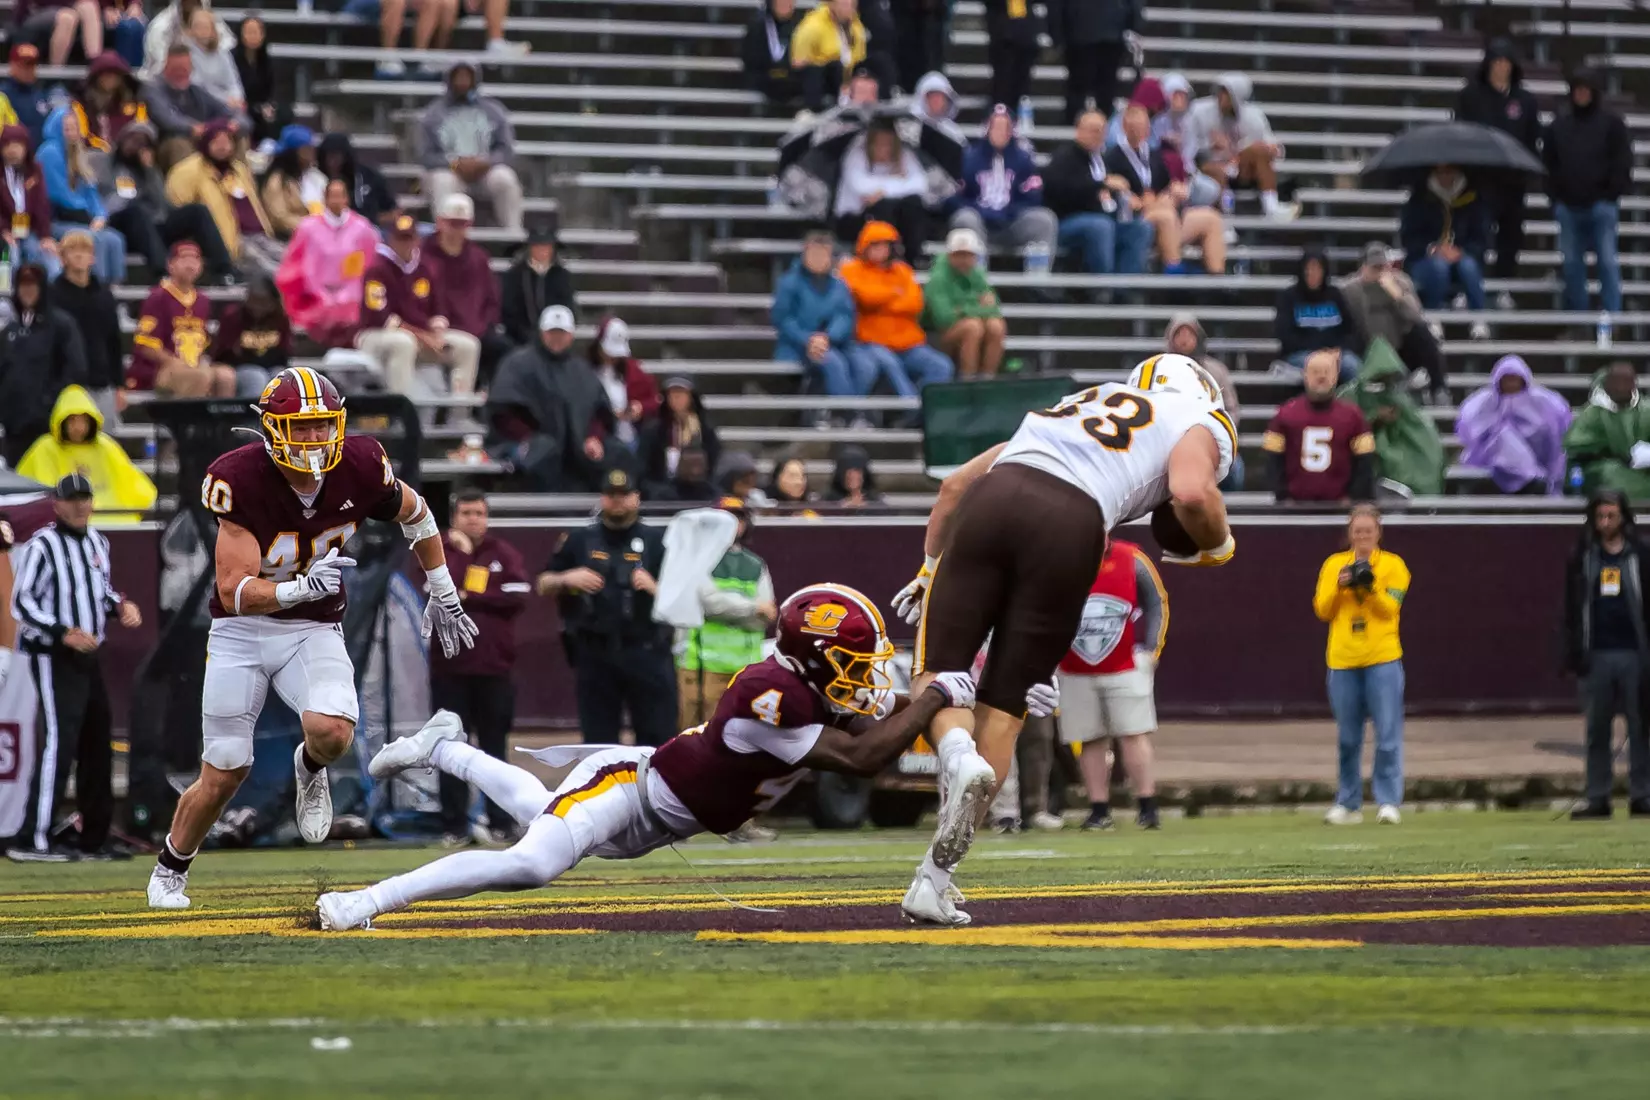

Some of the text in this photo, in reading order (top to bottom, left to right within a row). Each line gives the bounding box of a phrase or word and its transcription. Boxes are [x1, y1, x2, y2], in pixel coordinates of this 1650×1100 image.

[1301, 425, 1333, 473] 5
[201, 473, 232, 514] 40
[260, 521, 357, 583] 40
[751, 688, 783, 727] 4
